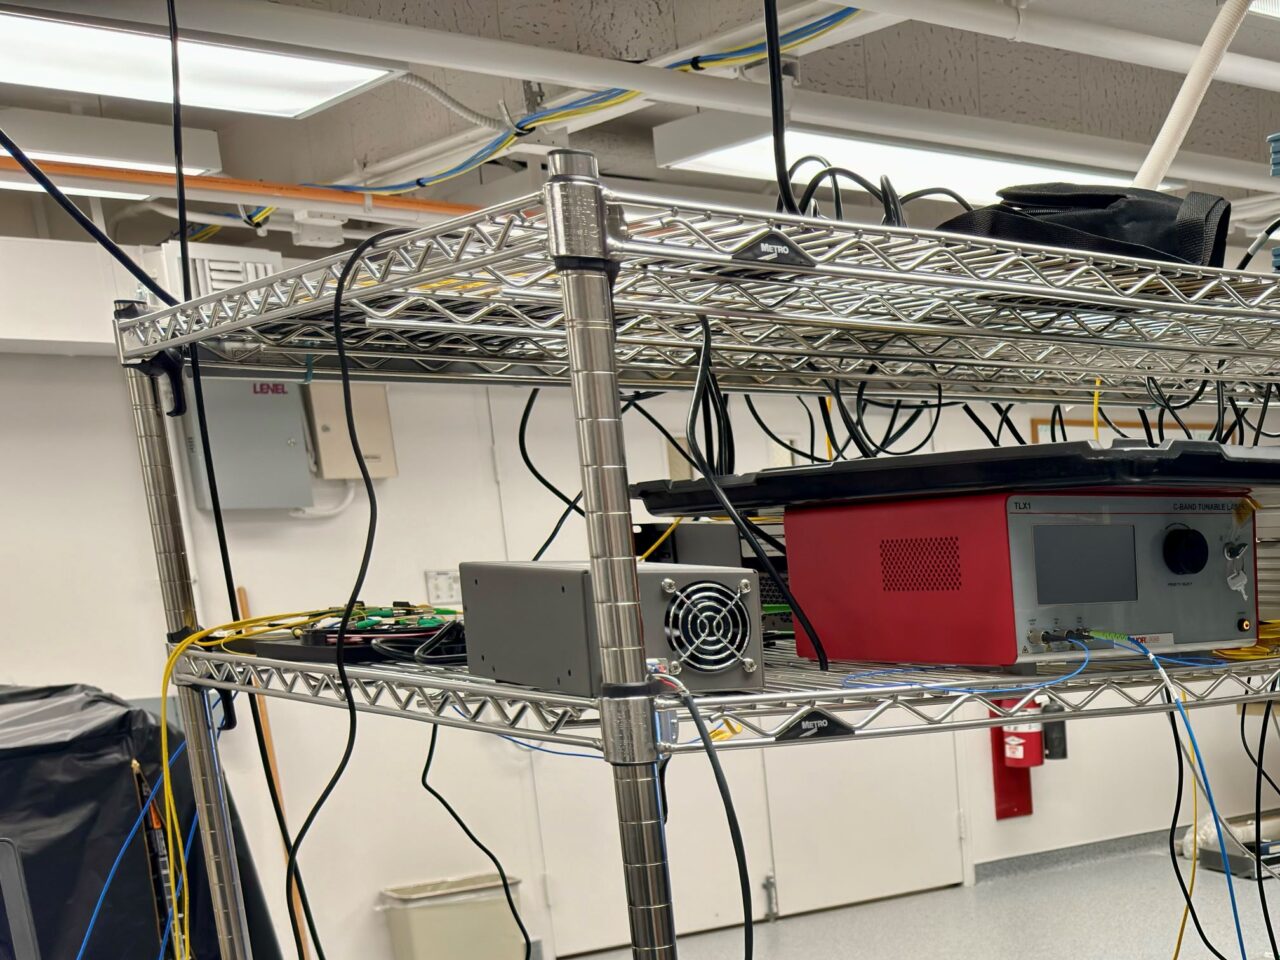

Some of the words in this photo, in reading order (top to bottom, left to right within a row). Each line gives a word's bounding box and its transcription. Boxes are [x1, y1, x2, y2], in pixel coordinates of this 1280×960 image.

[760, 243, 789, 254] METRO
[253, 383, 288, 395] LENEL
[1014, 502, 1031, 510] TLX1
[1173, 503, 1197, 511] C-BAND
[1198, 503, 1226, 511] TUNABLE
[801, 719, 828, 729] METRO
